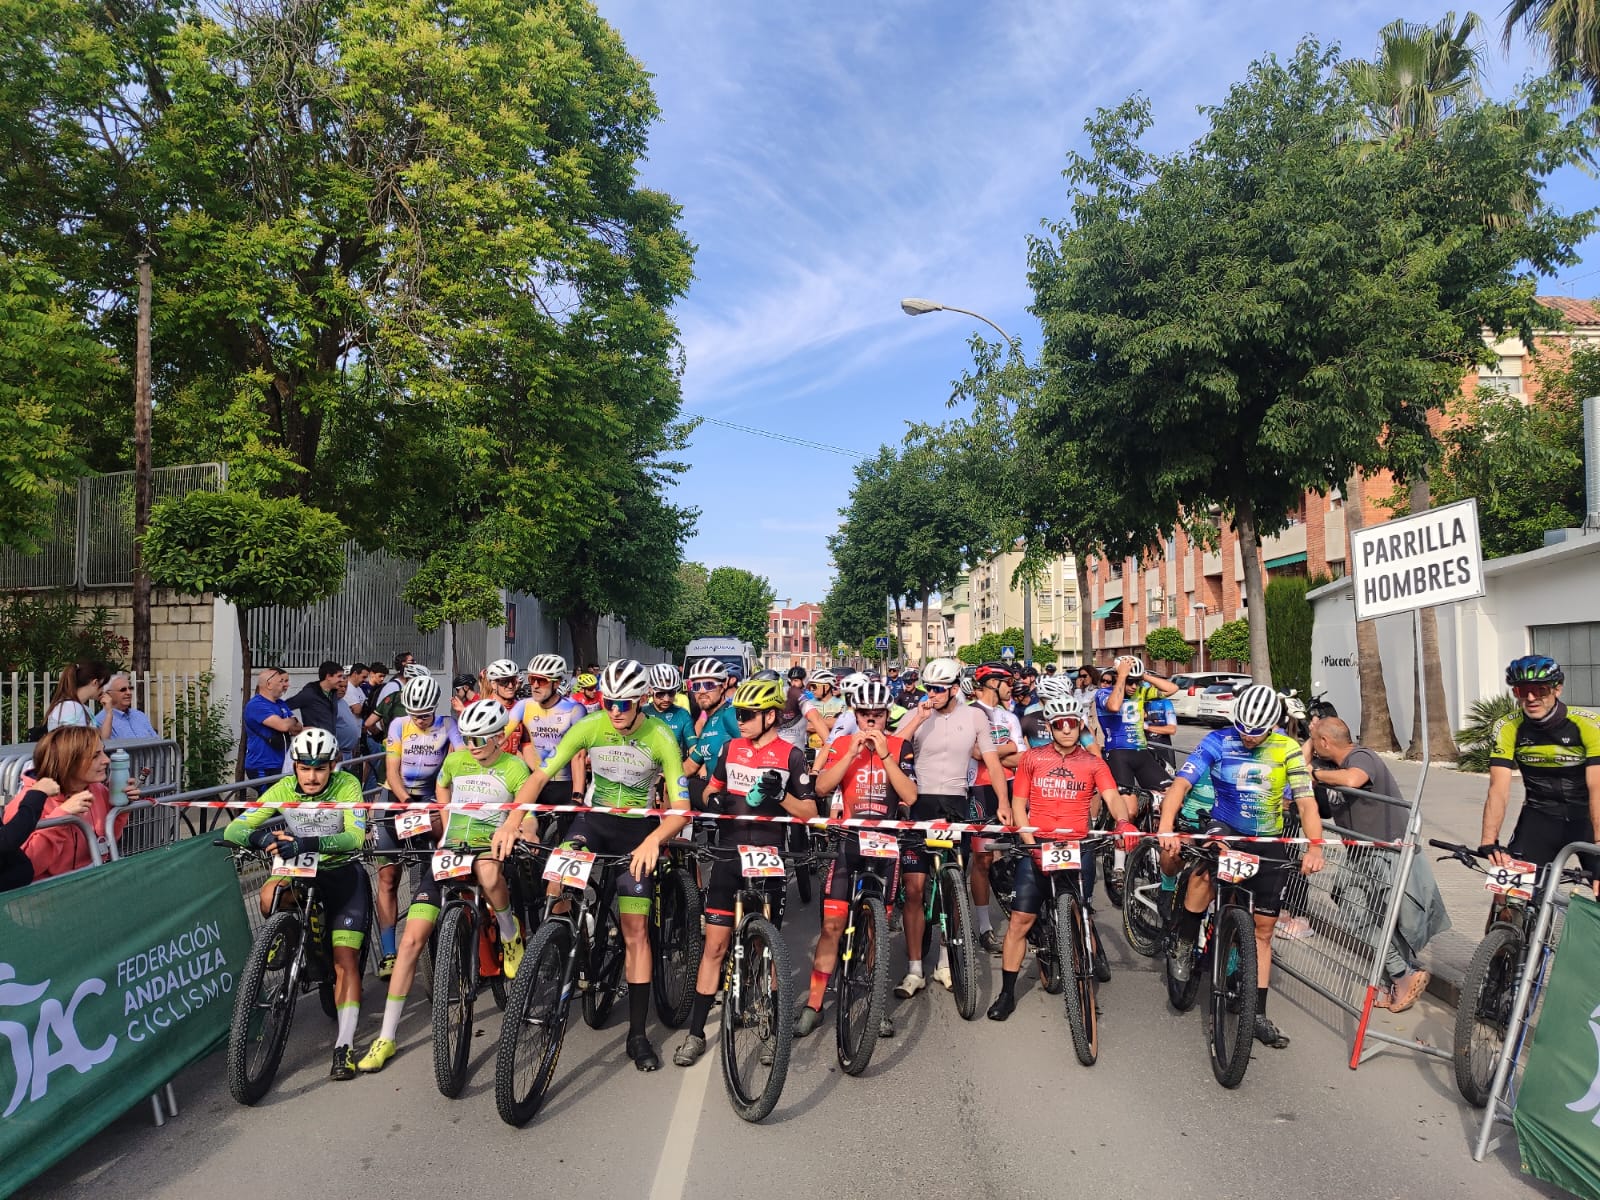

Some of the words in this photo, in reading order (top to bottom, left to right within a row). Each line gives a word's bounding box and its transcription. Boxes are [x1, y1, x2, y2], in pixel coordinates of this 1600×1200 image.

[1362, 517, 1466, 568] PARRILLA
[1364, 555, 1471, 605] HOMBRES
[402, 815, 423, 830] 52
[440, 854, 464, 871] 80
[556, 856, 581, 877] 76
[744, 851, 781, 868] 123
[1050, 849, 1072, 864] 39
[1223, 857, 1255, 879] 113
[1495, 868, 1523, 888] 84
[117, 920, 221, 988] FEDERACIÓN
[123, 947, 227, 1017] ANDALUZA
[127, 972, 233, 1042] CICLISMO
